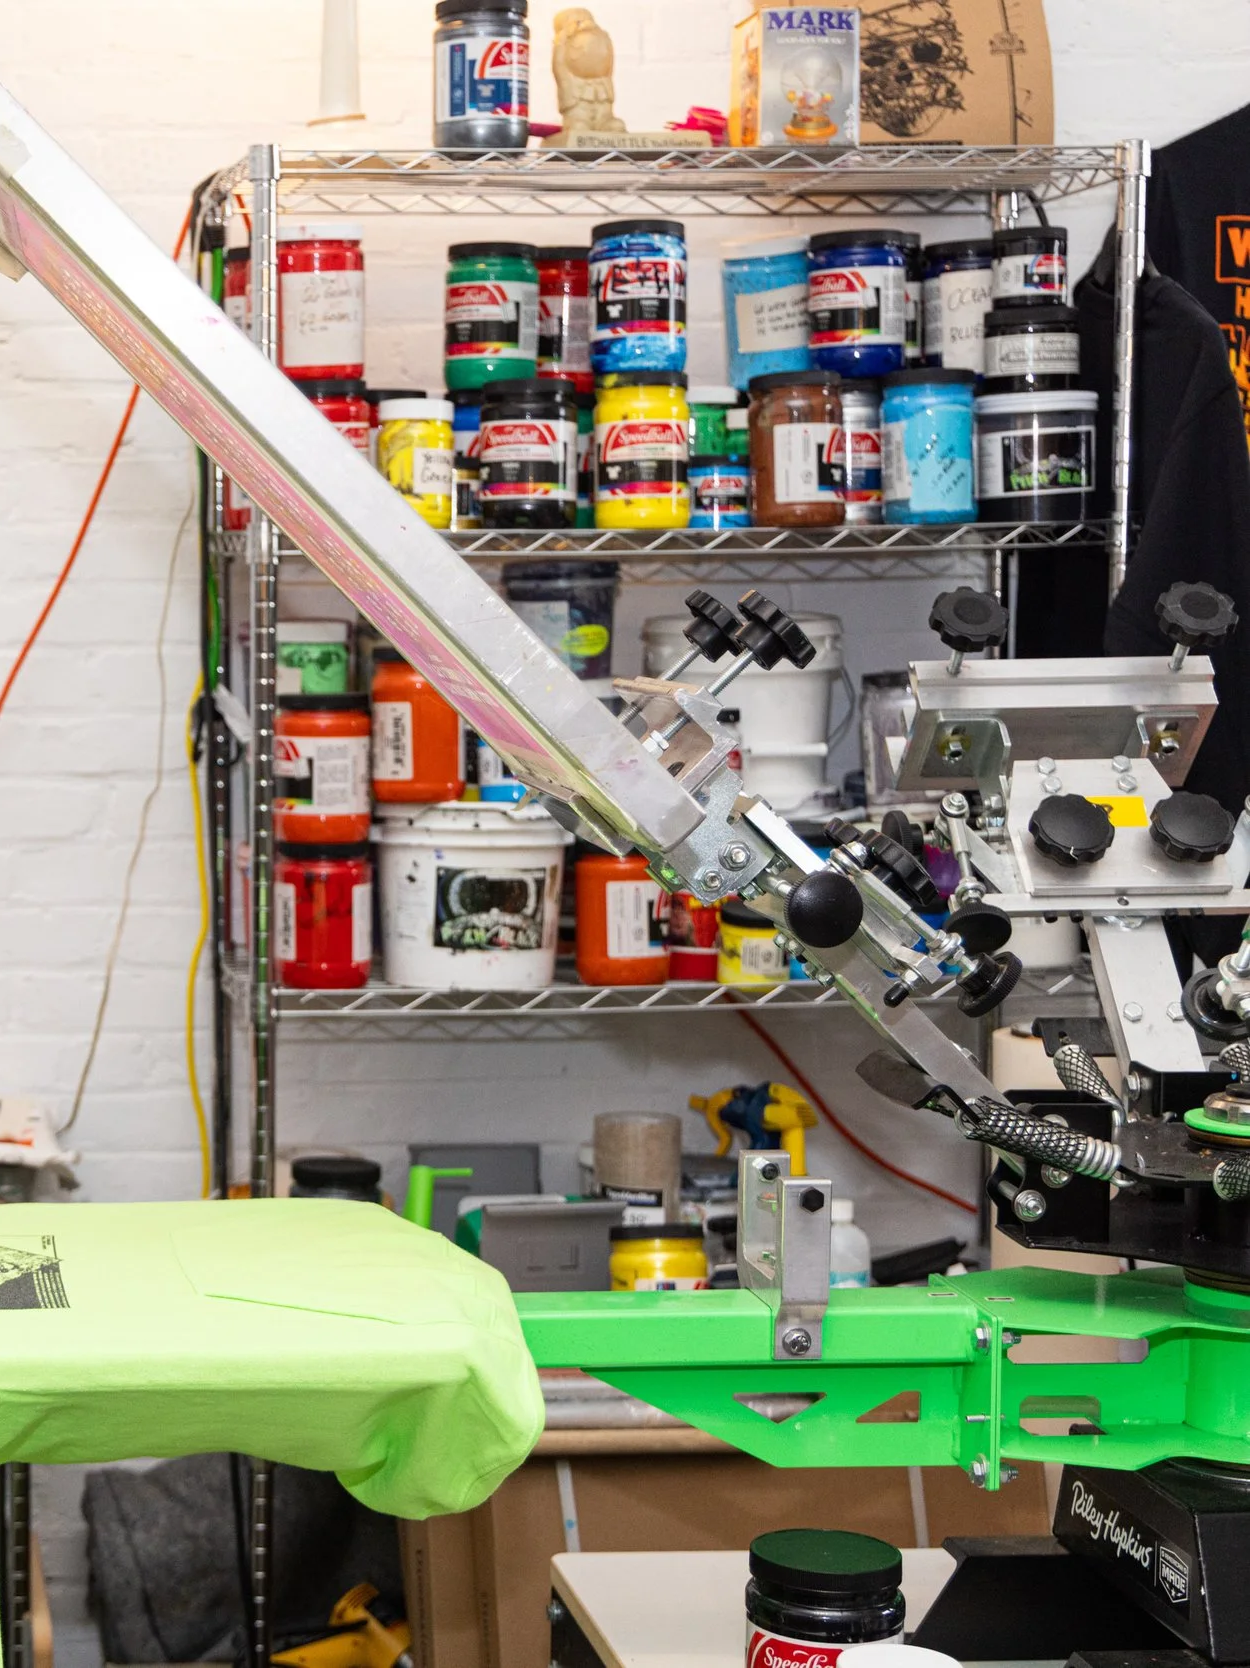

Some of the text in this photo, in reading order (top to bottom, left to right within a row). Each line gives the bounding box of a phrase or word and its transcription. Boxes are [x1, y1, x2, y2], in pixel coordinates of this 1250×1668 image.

[766, 10, 855, 31] MARK
[805, 27, 827, 37] SIX
[1071, 1480, 1153, 1568] Riley Hopkins
[1161, 1563, 1186, 1594] MADE
